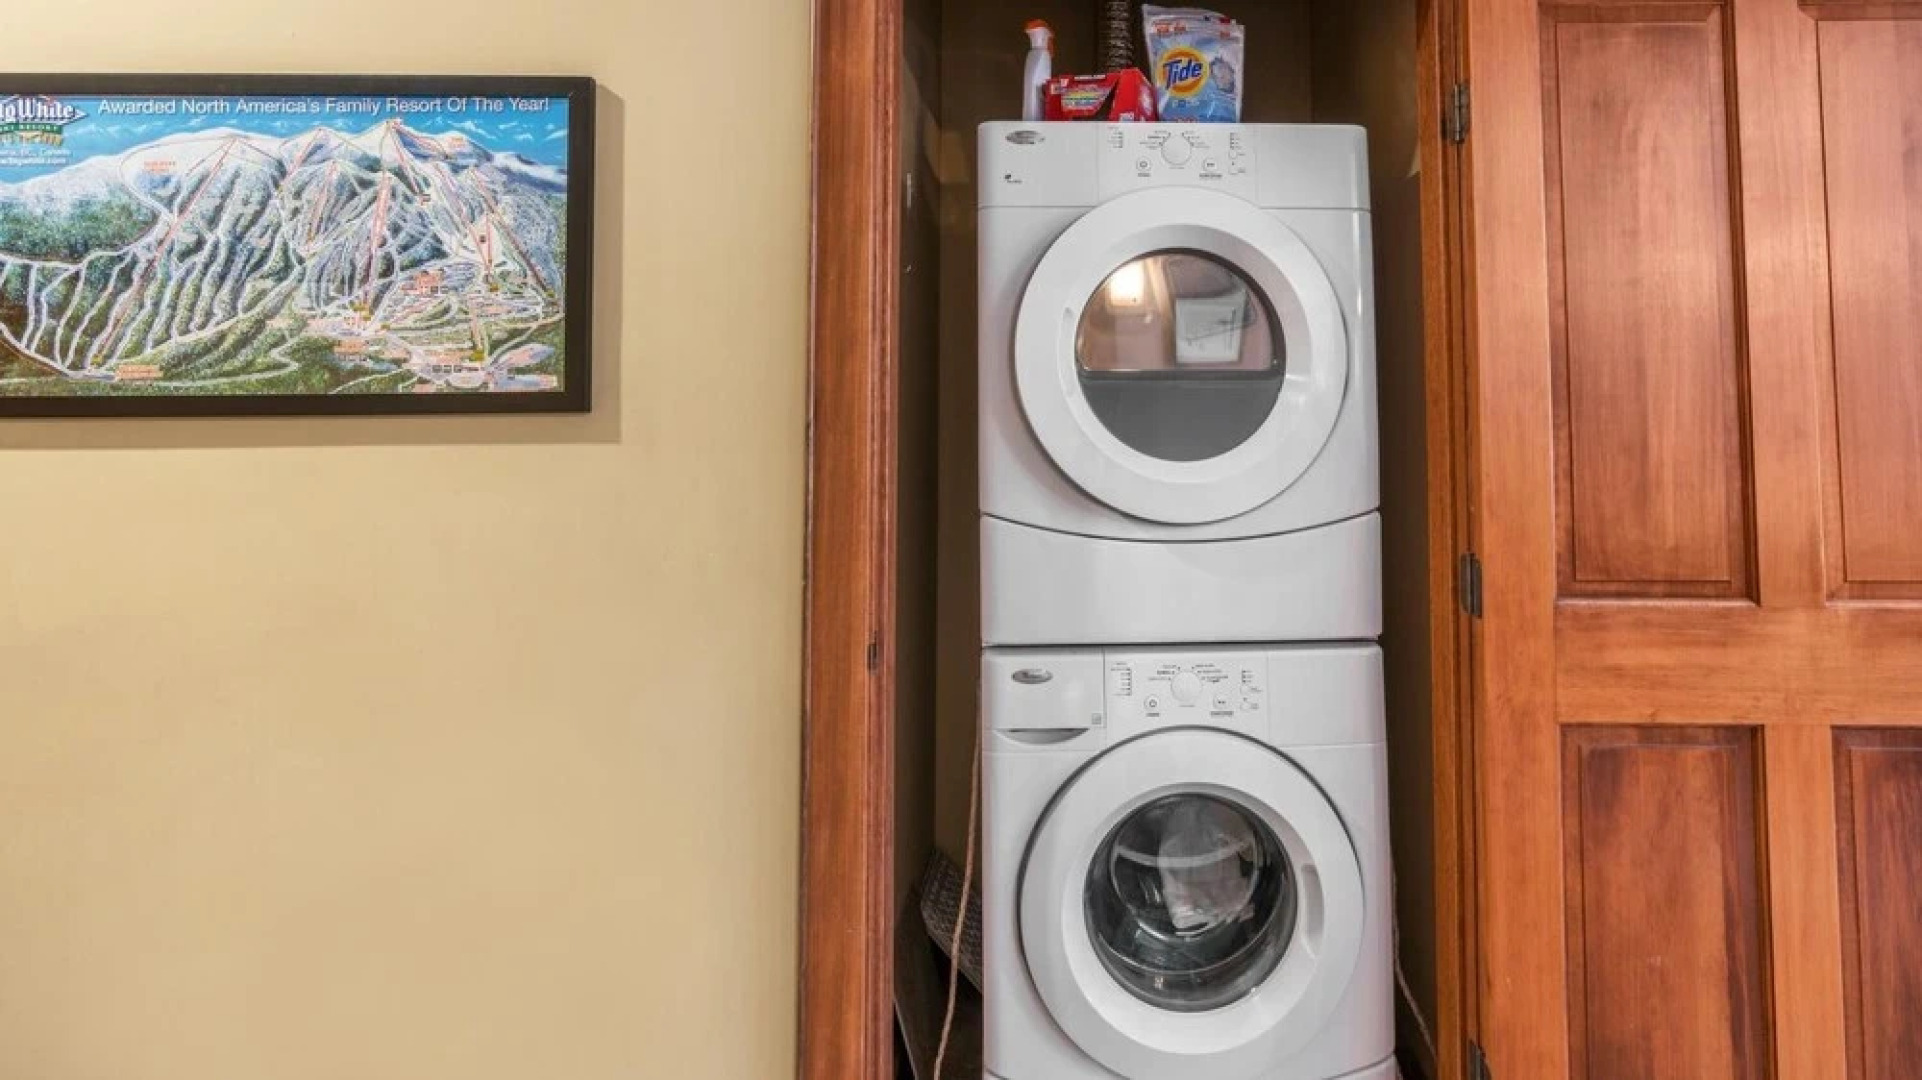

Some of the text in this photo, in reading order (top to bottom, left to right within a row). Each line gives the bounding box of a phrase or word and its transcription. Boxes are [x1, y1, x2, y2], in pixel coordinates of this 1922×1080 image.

[1163, 58, 1204, 90] Tide
[98, 97, 550, 115] Awarded North America's Family Resort Of The Year!
